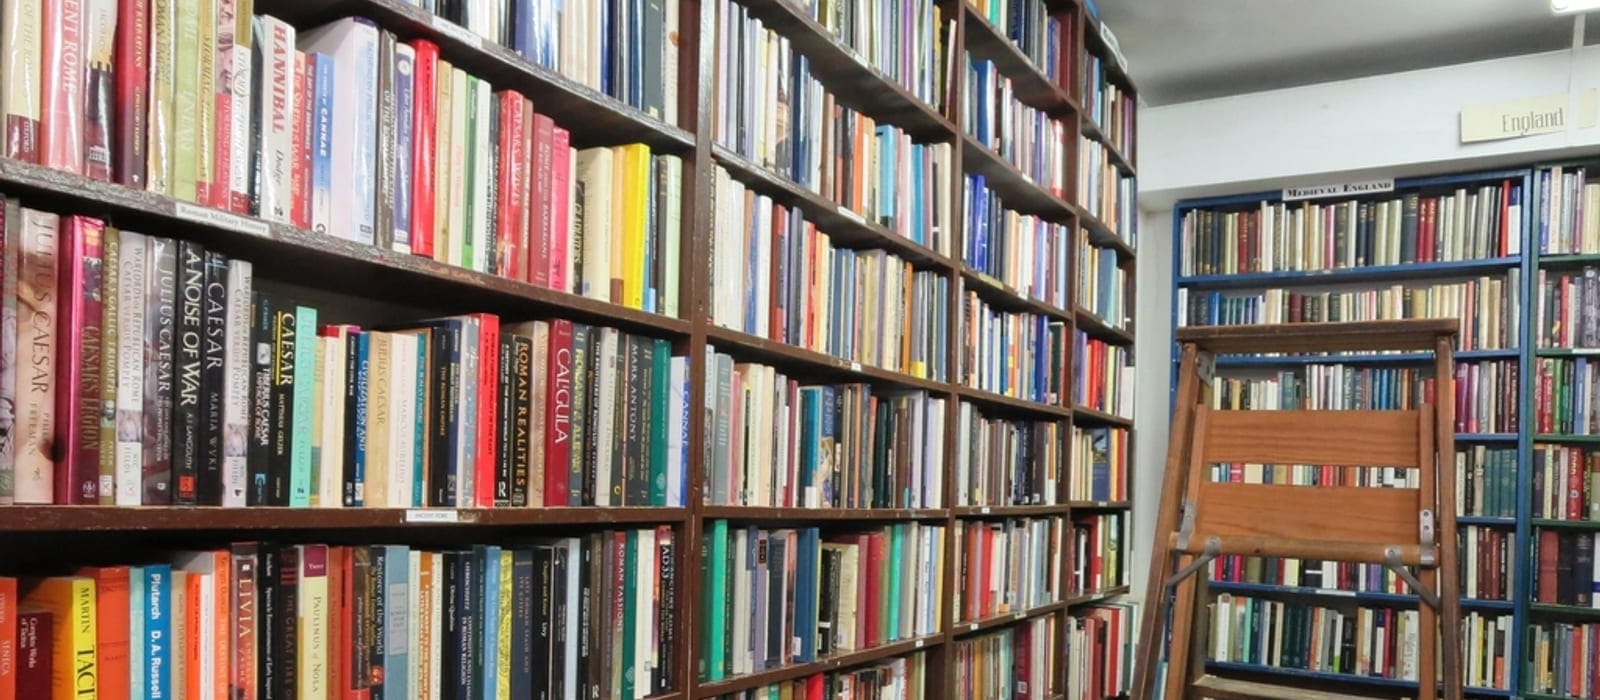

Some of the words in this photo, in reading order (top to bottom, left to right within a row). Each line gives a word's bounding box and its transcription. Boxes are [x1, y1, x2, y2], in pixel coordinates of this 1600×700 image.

[63, 40, 78, 94] ROME
[272, 24, 287, 133] HANNIBAL
[320, 107, 328, 157] CANNAE
[1502, 107, 1564, 134] England
[274, 150, 284, 185] Dodge
[1287, 187, 1337, 198] MEDIEVAL
[1343, 182, 1392, 193] ENGLAND
[34, 220, 52, 302] JULIUS
[132, 247, 142, 300] WARLORDS
[187, 249, 200, 264] A
[123, 261, 133, 302] CAESAR
[160, 268, 171, 327] JULIUS
[183, 264, 202, 325] NOISE
[242, 275, 250, 326] WARLORDS
[107, 296, 117, 337] GALLIC
[206, 282, 225, 370] CAESAR
[234, 289, 242, 327] CAESAR
[31, 311, 51, 393] CAESAR
[106, 339, 116, 393] TRIUMPH
[132, 312, 142, 372] REPUBLICAN
[158, 330, 171, 392] CAESAR
[183, 331, 200, 358] OF
[241, 335, 249, 390] REPUBLICAN
[280, 313, 295, 385] CAESAR
[122, 345, 133, 388] POMPEY
[131, 375, 140, 402] ROME
[180, 360, 200, 405] WAR
[518, 342, 528, 400] ROMAN
[208, 392, 218, 431] MARIA
[360, 360, 369, 426] CIVILIZATION
[377, 378, 387, 425] CAESAR
[555, 348, 571, 443] CALIGULA
[630, 386, 638, 442] ANTONY
[81, 398, 99, 451] LEGION
[261, 409, 270, 445] CAESAR
[359, 428, 367, 452] AND
[516, 406, 527, 486] REALITIES
[80, 587, 90, 633] MARTIN
[151, 573, 161, 620] Plutarch
[239, 578, 252, 637] LIVIA
[377, 597, 384, 607] of
[151, 630, 161, 642] D.
[313, 597, 321, 649] PAULINUS
[540, 622, 548, 637] Livy
[2, 640, 10, 676] SENECA
[77, 645, 95, 700] TACI
[151, 644, 161, 656] A.
[151, 657, 161, 699] Russell
[312, 663, 321, 693] NOLA
